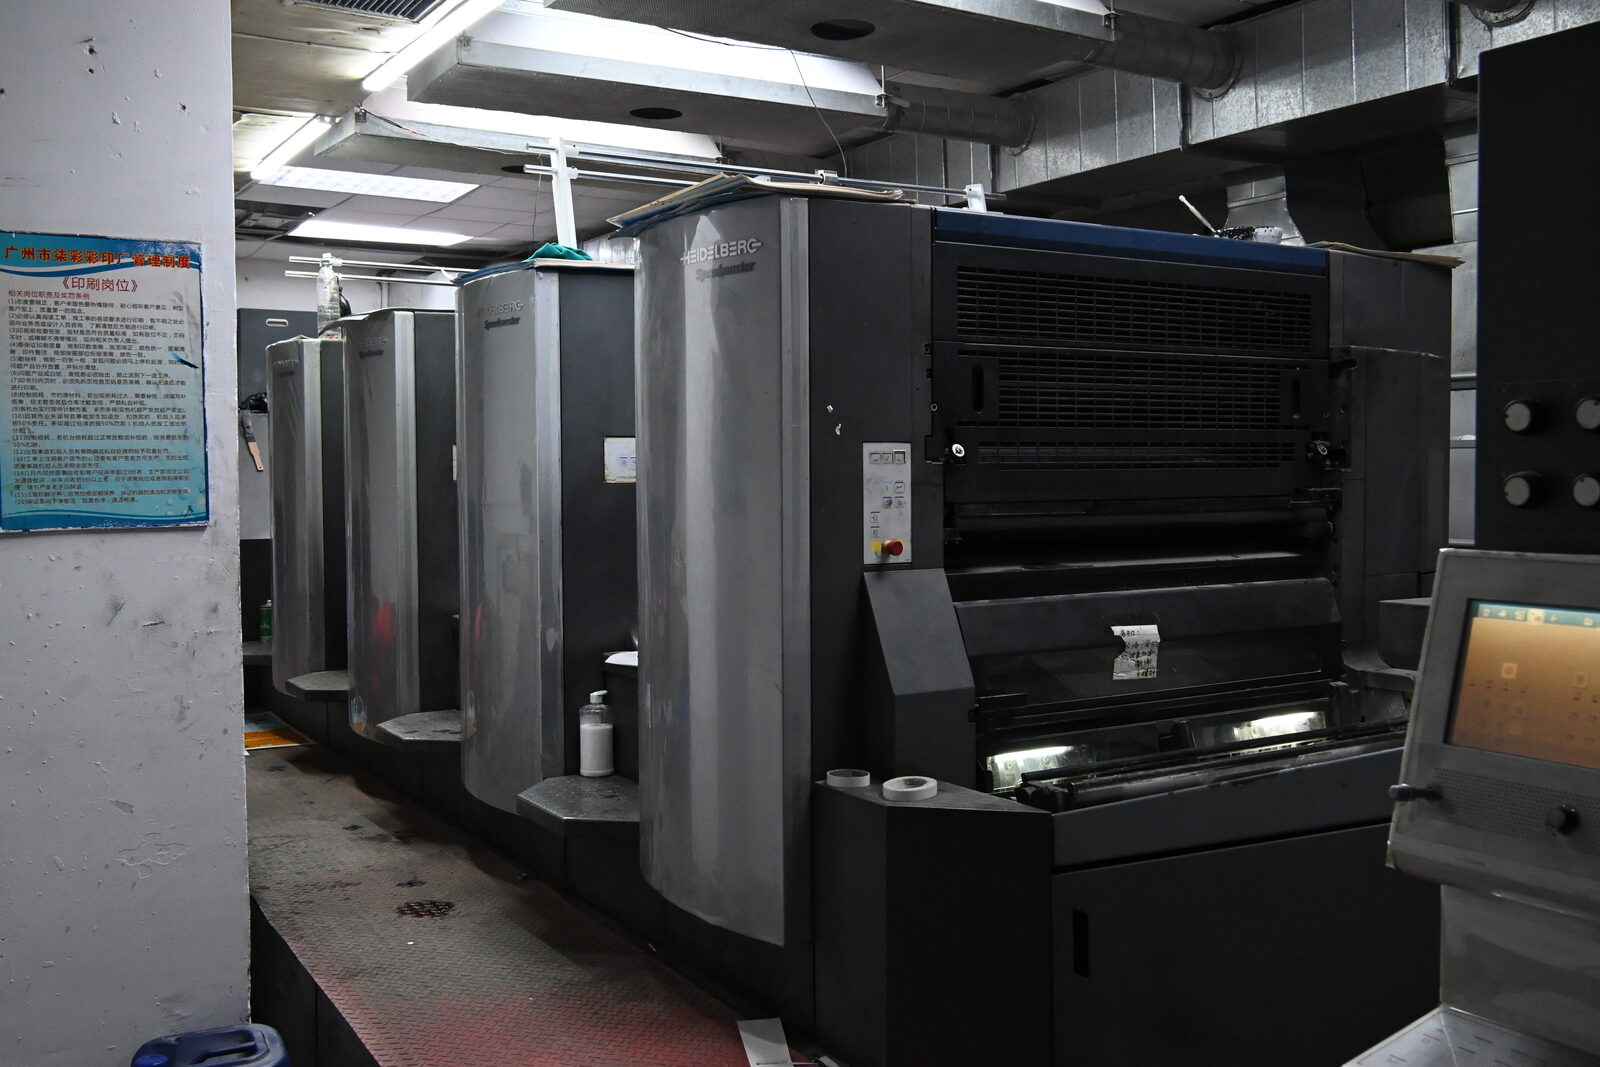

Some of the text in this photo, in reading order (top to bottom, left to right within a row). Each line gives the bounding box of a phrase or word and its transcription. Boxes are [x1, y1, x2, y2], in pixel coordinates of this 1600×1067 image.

[5, 246, 190, 269] 广州市柒彩彩印厂管理制度
[680, 238, 763, 265] HEIDELBERG
[62, 276, 138, 293] 《印刷岗位》
[478, 300, 525, 316] EDELBERG
